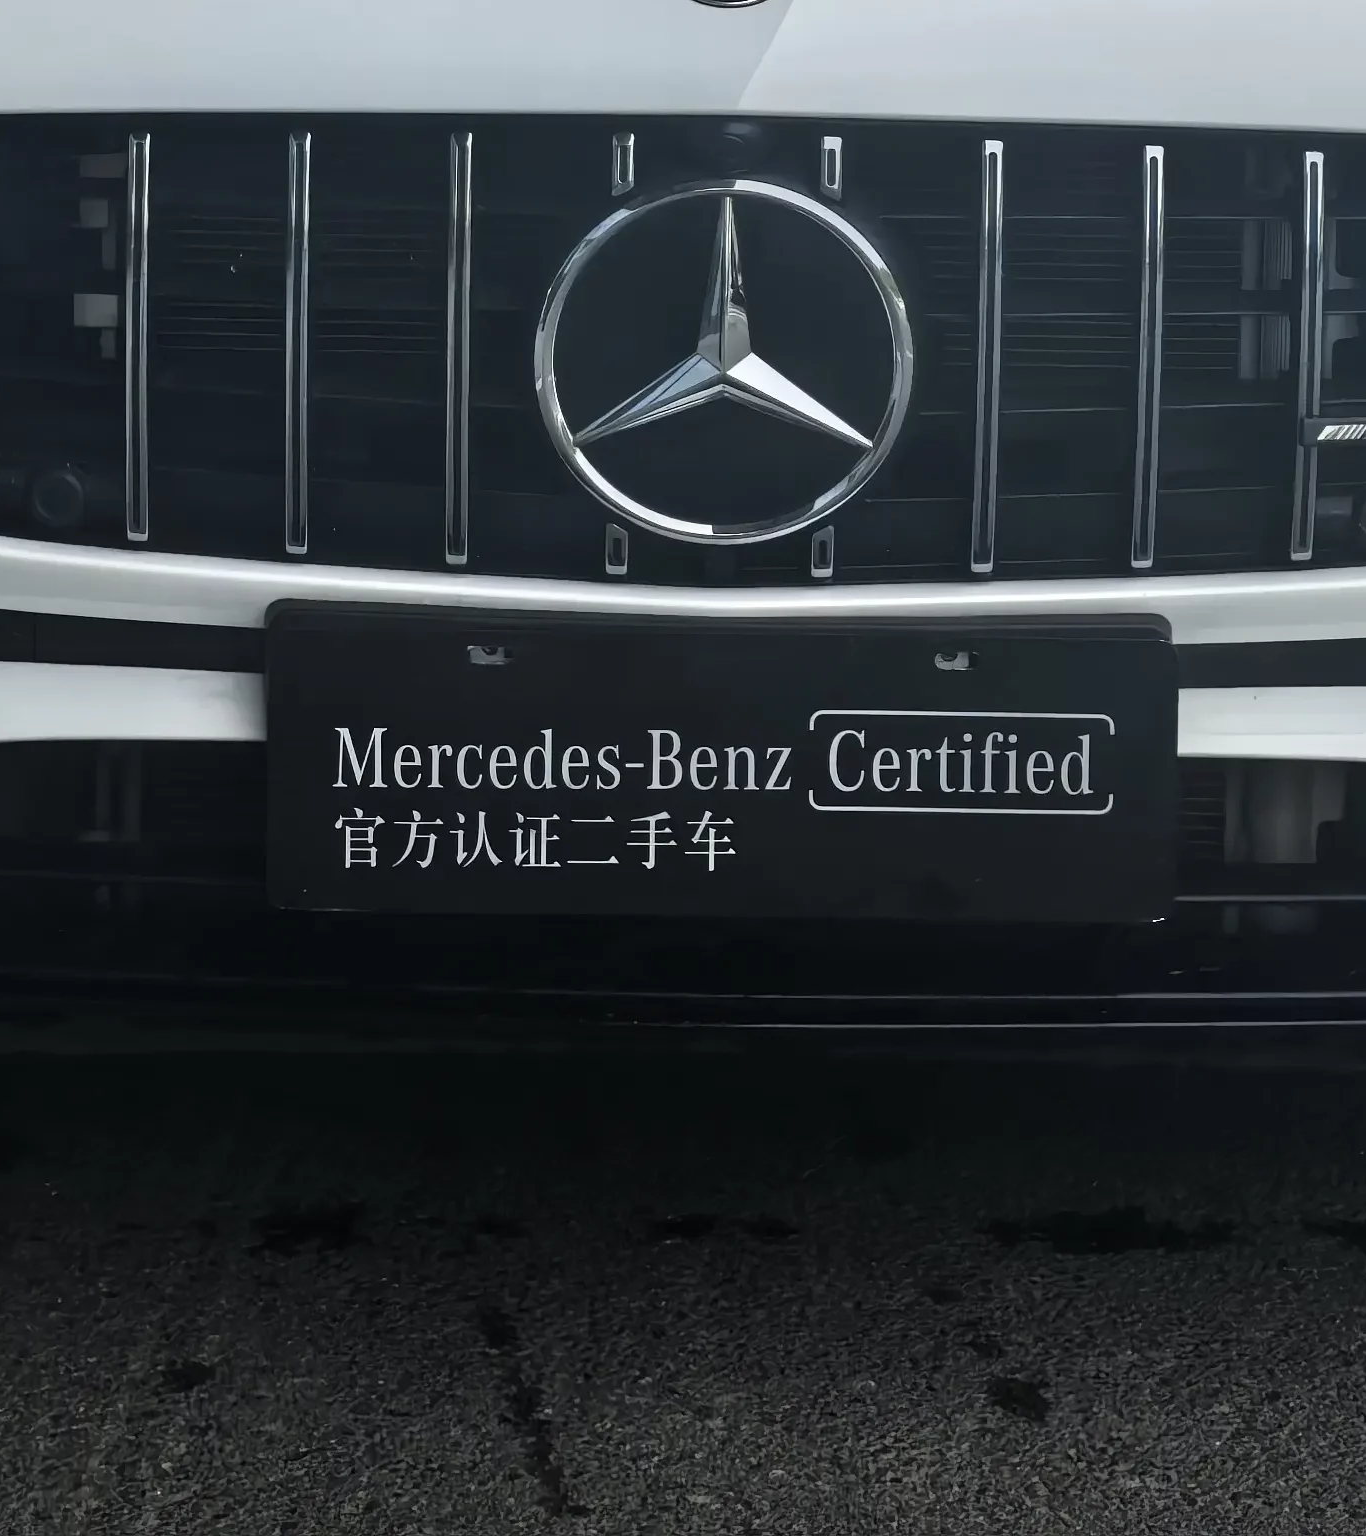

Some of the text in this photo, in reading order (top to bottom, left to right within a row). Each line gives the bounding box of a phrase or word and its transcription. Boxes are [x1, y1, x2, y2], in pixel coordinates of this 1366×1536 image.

[332, 727, 1094, 796] Mercedes-Benz Certified
[334, 807, 737, 872] 官方认证二手车
